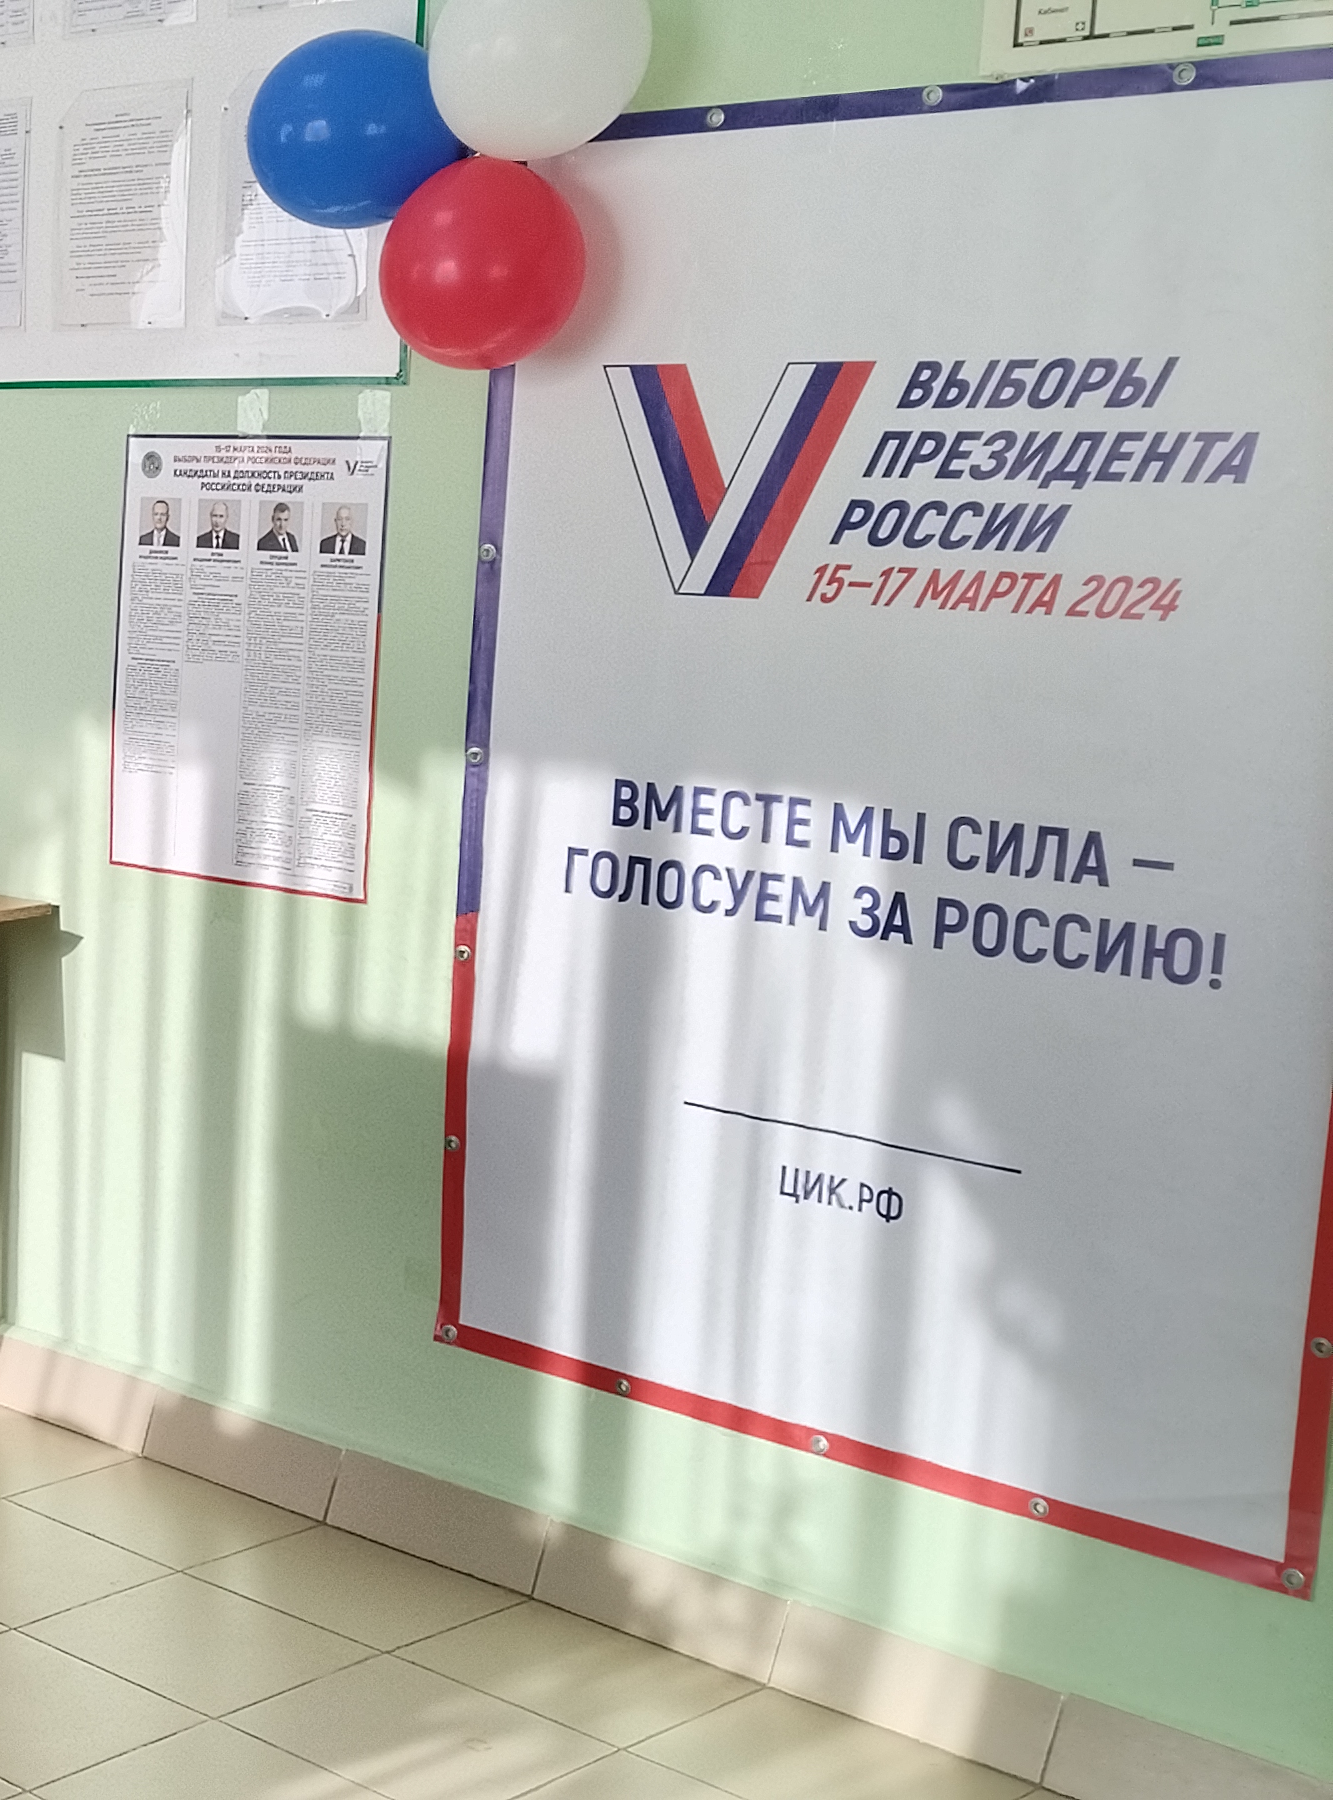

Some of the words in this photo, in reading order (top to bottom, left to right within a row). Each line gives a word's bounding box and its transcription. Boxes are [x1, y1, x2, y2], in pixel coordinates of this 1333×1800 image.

[897, 357, 1181, 409] ВЫБОРЫ
[173, 455, 201, 463] ВЫБОРЫ
[294, 456, 336, 466] ФЕДЕРАЦИИ
[173, 468, 220, 479] КАНДИДАТЫ
[221, 470, 231, 479] НА
[233, 469, 282, 481] ДОЛЖНОСТЬ
[283, 470, 335, 482] ПРЕЗИДЕНТА
[274, 446, 292, 454] ГОДА
[862, 431, 1261, 490] ПРЕЗИДЕНТА
[200, 481, 252, 493] РОССИЙСКОЙ
[254, 483, 304, 494] ФЕДЕРАЦИИ
[829, 499, 1073, 553] РОССИИ
[915, 569, 1063, 616] МАРТА
[1065, 575, 1183, 622] 2024
[612, 778, 813, 849] ВМЕСТЕ
[830, 802, 927, 865] МЫ
[947, 816, 1111, 888] СИЛА
[563, 846, 832, 933] ГОЛОСУЕМ
[849, 886, 914, 946] ЗА
[933, 897, 1227, 990] РОССИЮ!
[779, 1165, 904, 1224] ЦИК.РФ
